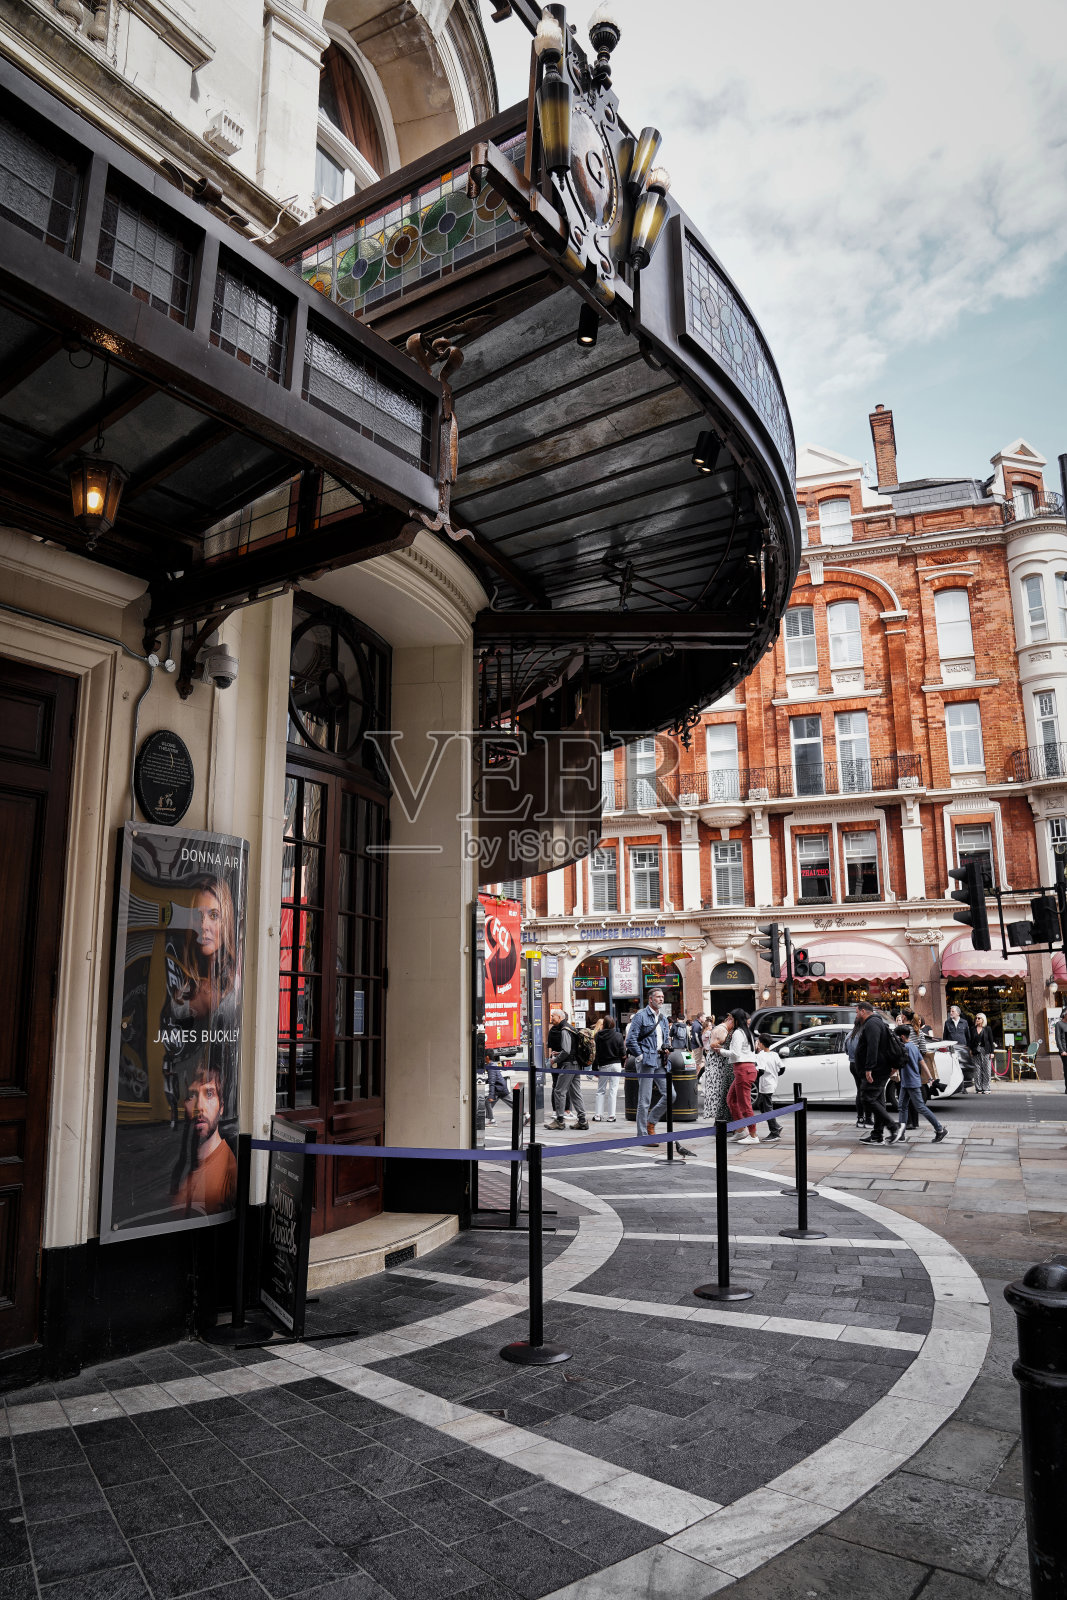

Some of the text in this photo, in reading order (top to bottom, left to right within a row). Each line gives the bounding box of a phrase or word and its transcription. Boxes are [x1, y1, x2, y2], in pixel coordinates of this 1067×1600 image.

[181, 847, 239, 870] DONNA AIR
[834, 917, 867, 928] Concerto
[492, 917, 510, 953] FCL
[580, 926, 666, 941] CHINESE MEDICINE
[726, 970, 739, 979] 52
[153, 1027, 240, 1043] JAMES BUCKLEY
